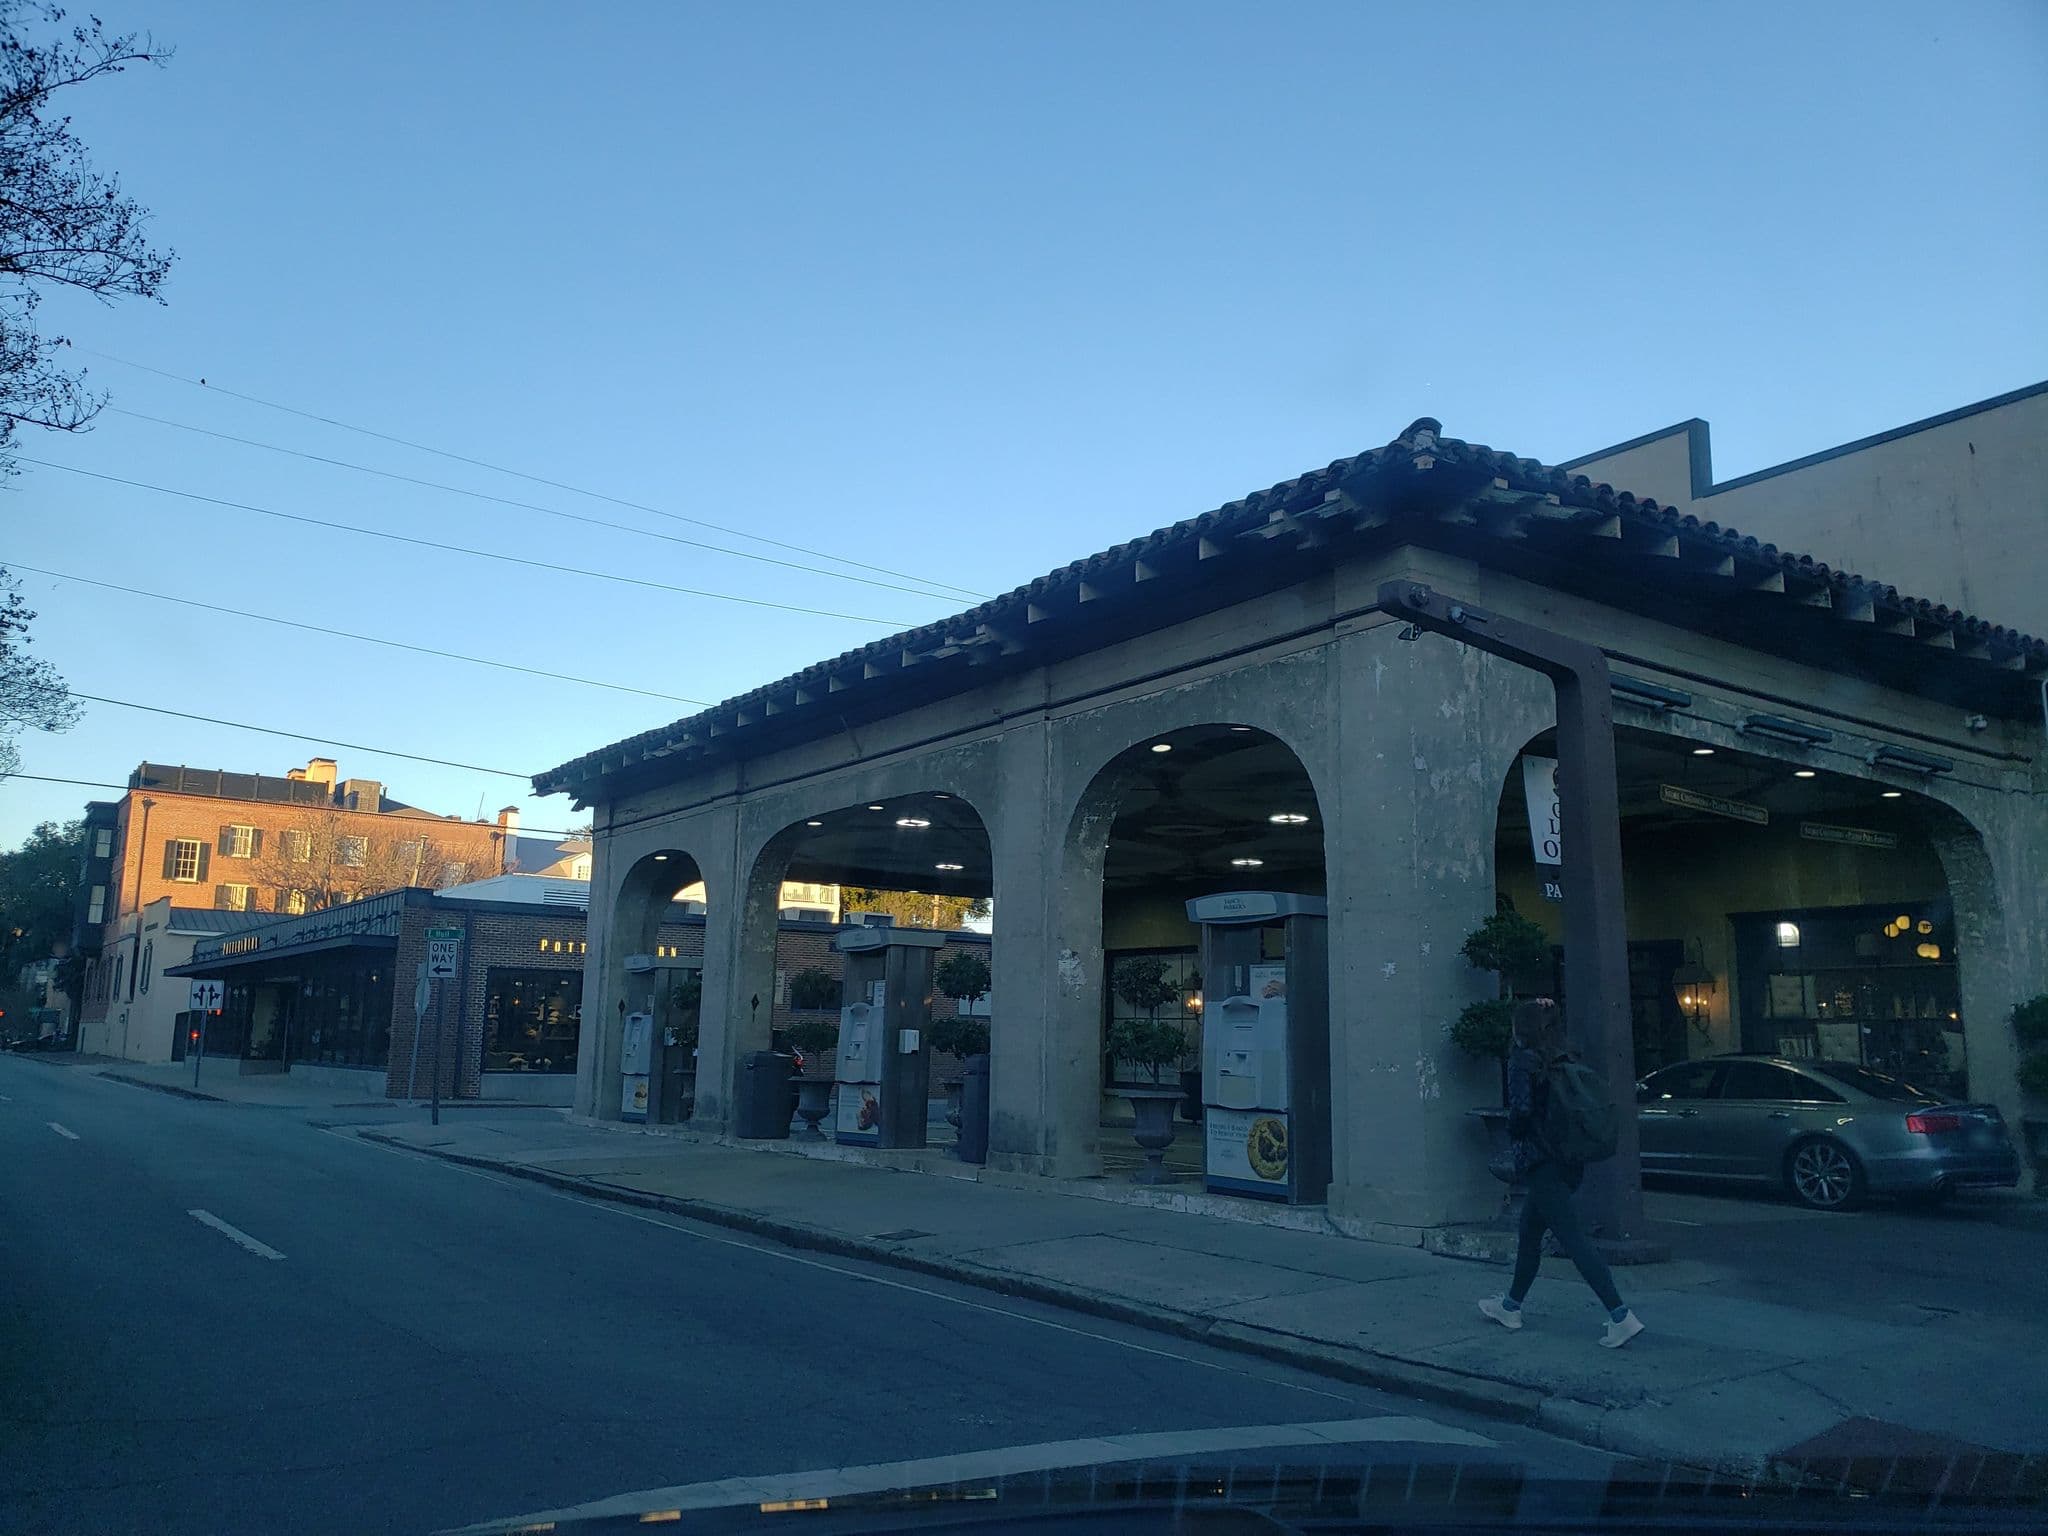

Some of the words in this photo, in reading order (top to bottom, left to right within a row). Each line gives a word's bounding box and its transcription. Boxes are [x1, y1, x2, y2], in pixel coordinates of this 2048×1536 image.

[432, 943, 454, 953] ONE
[541, 939, 587, 954] POTT
[658, 946, 677, 957] RN
[431, 953, 454, 963] WAY
